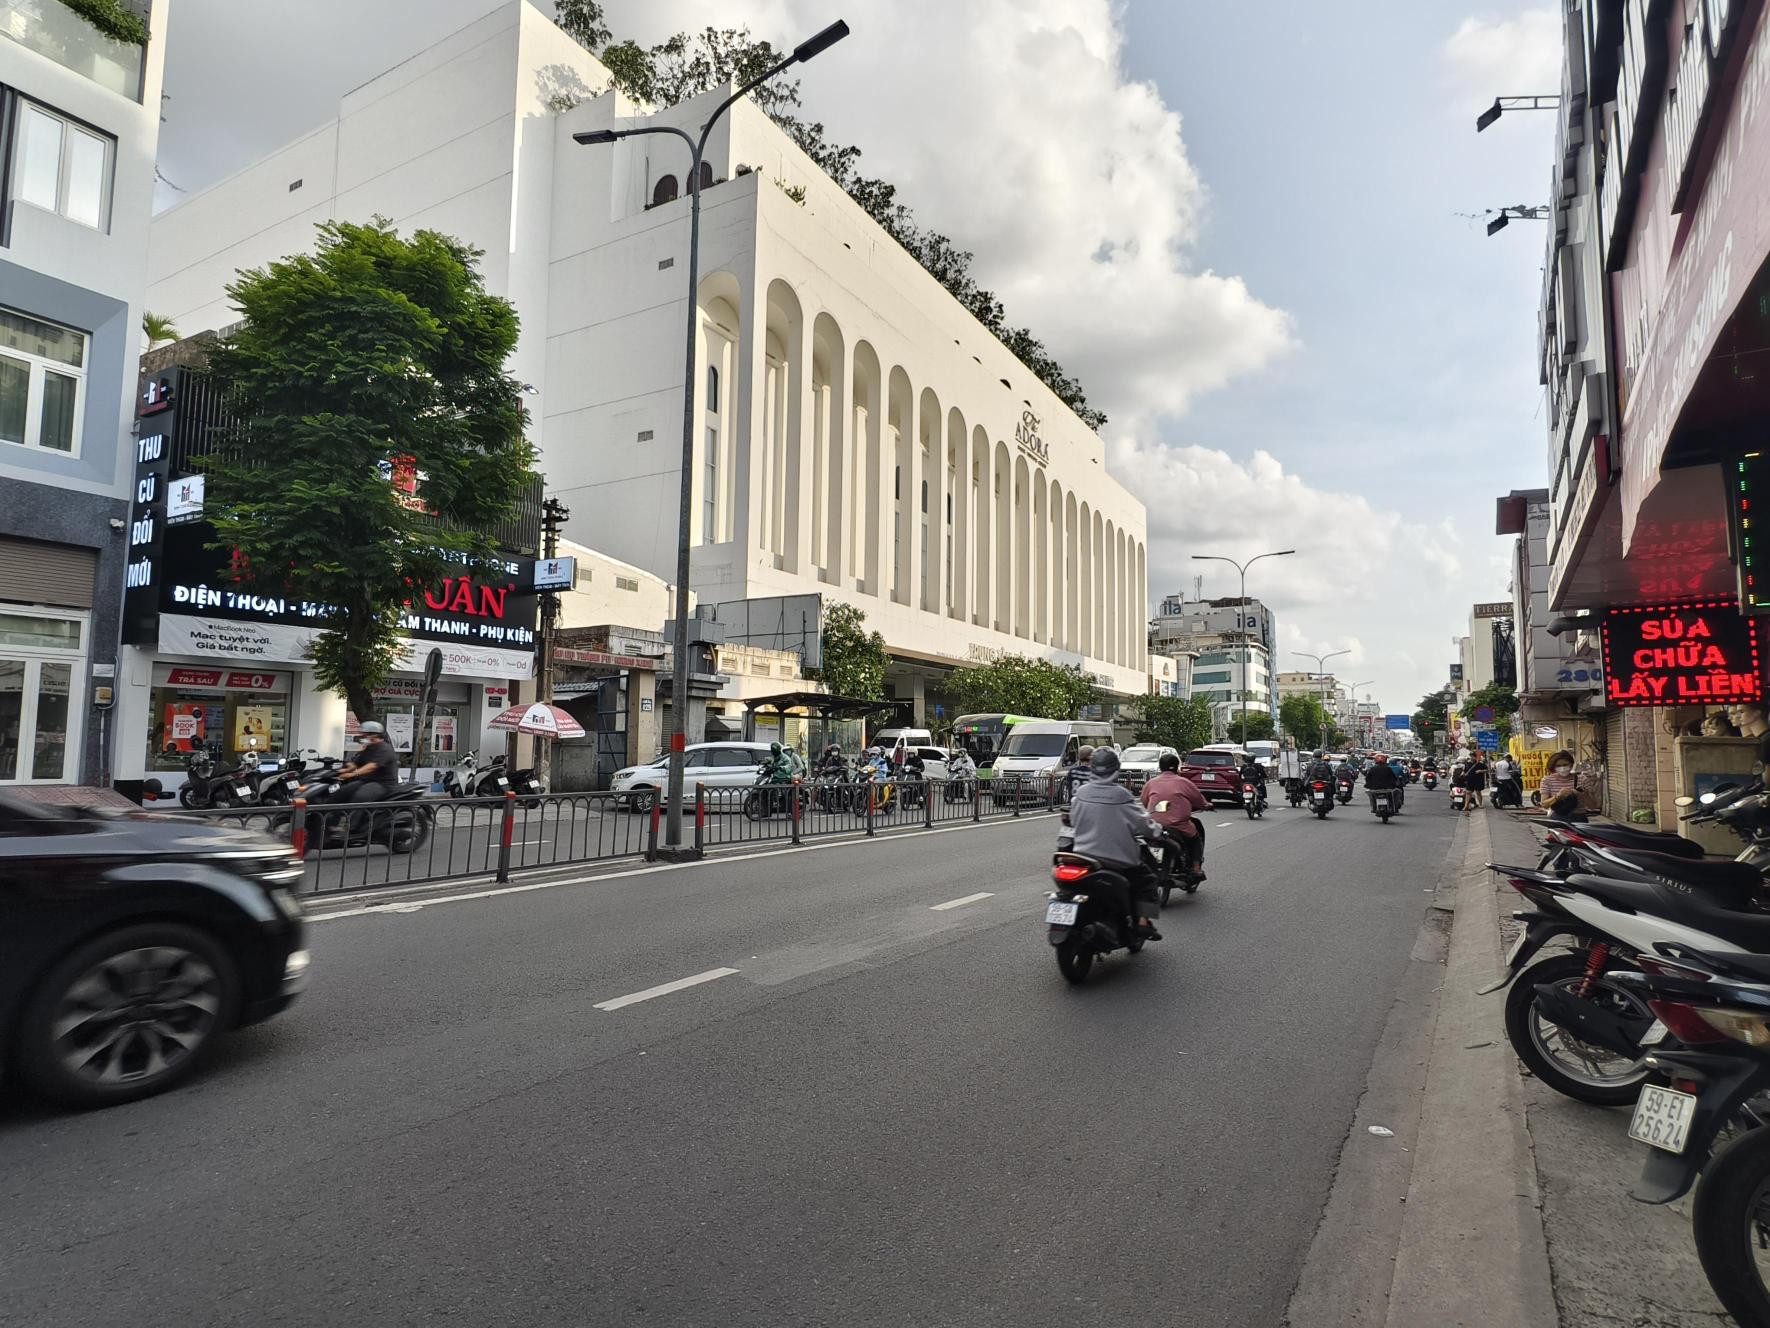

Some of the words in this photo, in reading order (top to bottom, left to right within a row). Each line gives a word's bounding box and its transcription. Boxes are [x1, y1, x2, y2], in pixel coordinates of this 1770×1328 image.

[138, 434, 163, 463] THU
[1015, 421, 1049, 461] ADORA
[138, 472, 155, 504] CŨ
[132, 509, 154, 546] ĐỔI
[127, 556, 152, 588] MỚI
[174, 584, 221, 609] ĐIỆN
[226, 592, 285, 616] THOẠI
[1163, 600, 1182, 615] ila
[424, 617, 469, 636] THANH
[480, 625, 505, 643] PHỤ
[506, 626, 533, 645] KIỆN
[1236, 613, 1257, 628] ia
[190, 631, 217, 640] Mac
[219, 634, 250, 645] tuyệt
[252, 637, 273, 645] với.
[196, 641, 216, 650] Giá
[218, 642, 239, 652] bất
[241, 646, 266, 654] ngờ.
[448, 654, 472, 665] 500K
[1655, 874, 1694, 895] SIRIUS
[1646, 1091, 1686, 1122] 59-E1
